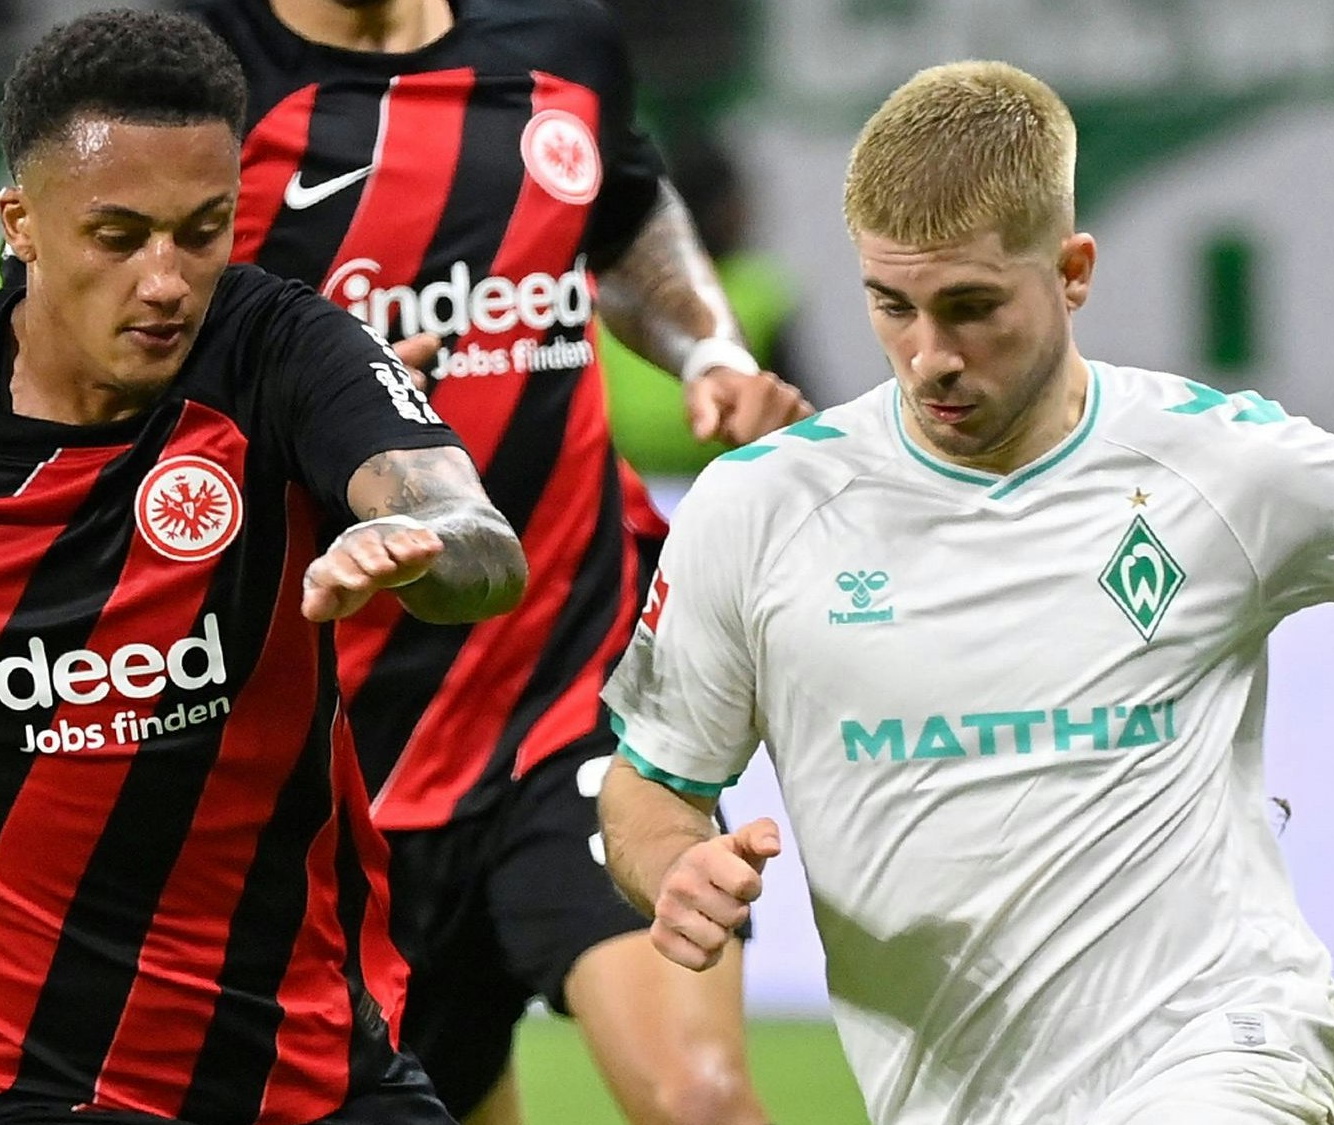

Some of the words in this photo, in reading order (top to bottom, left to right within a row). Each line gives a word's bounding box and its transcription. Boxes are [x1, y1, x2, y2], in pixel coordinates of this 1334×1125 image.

[323, 253, 592, 337] indeed
[431, 341, 510, 380] Jobs
[828, 605, 894, 624] hummel
[20, 719, 105, 755] Jobs
[111, 696, 231, 745] finden
[840, 698, 1177, 762] MATTHÄI
